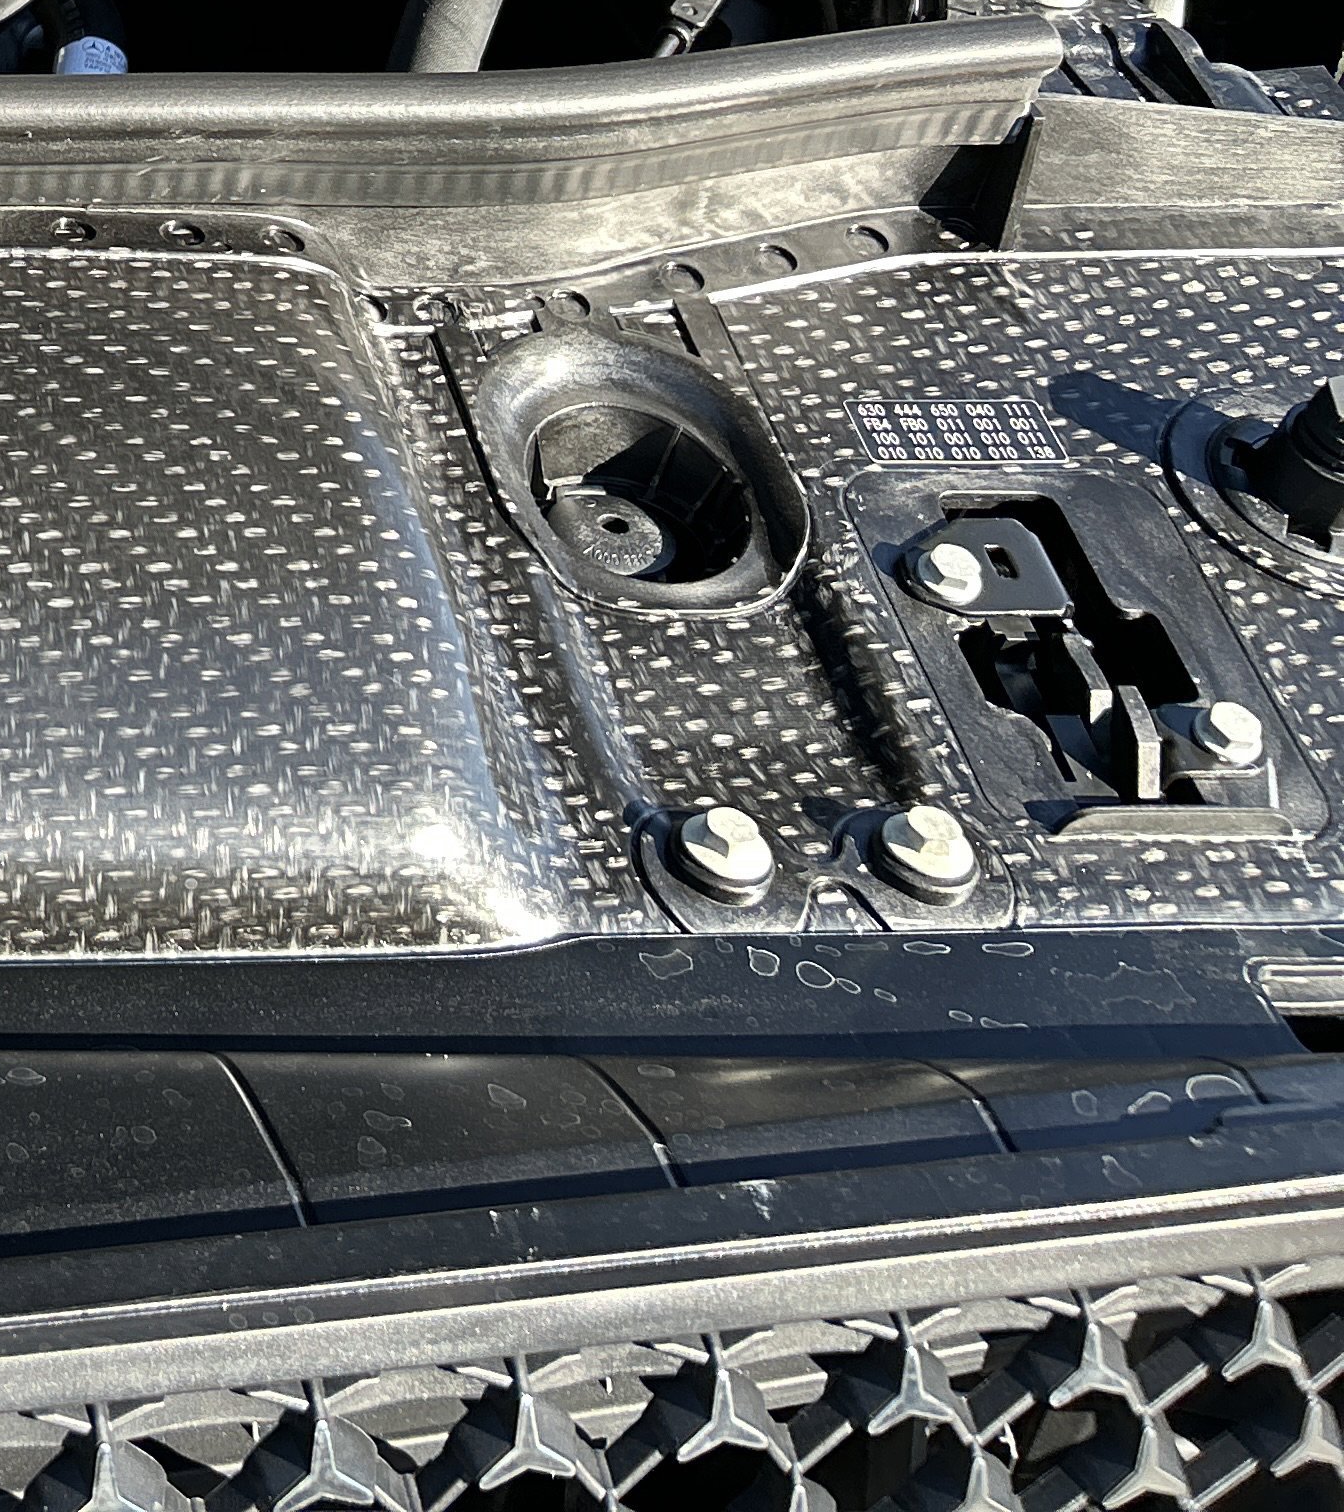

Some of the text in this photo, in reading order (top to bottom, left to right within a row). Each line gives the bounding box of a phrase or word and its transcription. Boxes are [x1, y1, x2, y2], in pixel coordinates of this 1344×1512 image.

[858, 404, 1032, 416] 630 444 650 040 111
[863, 418, 1039, 431] FB4 FB0 011 001 001
[872, 432, 1046, 445] 100 101 001 010 011
[877, 446, 907, 459] 010
[915, 446, 944, 459] 010
[951, 446, 981, 459] 010
[988, 446, 1018, 459] 010
